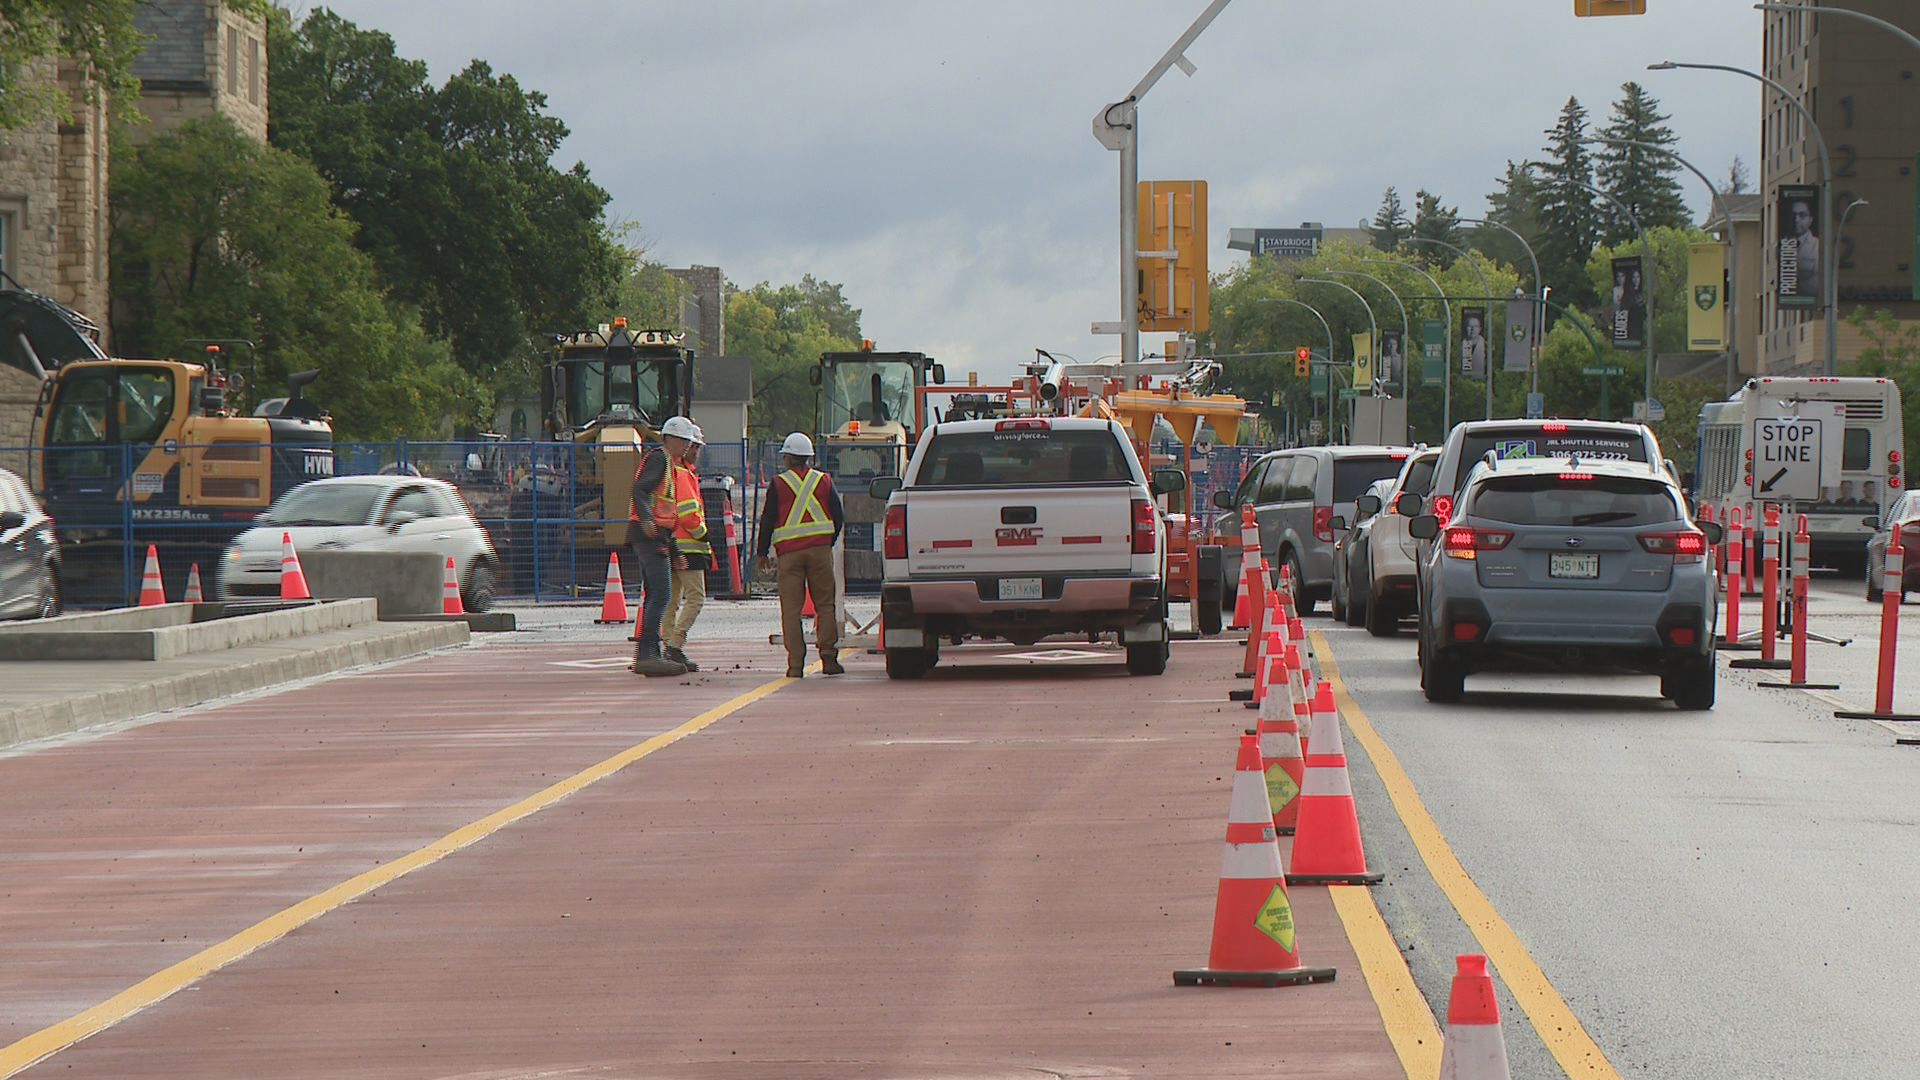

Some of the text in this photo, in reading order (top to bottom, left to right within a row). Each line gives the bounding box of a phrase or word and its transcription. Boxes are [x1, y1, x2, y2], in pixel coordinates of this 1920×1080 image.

[1265, 237, 1312, 247] STAYBRIDGE
[1780, 238, 1798, 295] PROTECTORS
[1614, 310, 1628, 339] LEADERS
[1311, 425, 1321, 433] 50
[1762, 425, 1814, 442] STOP
[1560, 439, 1594, 447] SHUTTLE
[1595, 440, 1630, 448] SERVICES
[1764, 445, 1811, 462] LINE
[995, 527, 1044, 539] GMC
[1552, 559, 1597, 573] 345 NTT
[1000, 584, 1041, 596] 351 KNR
